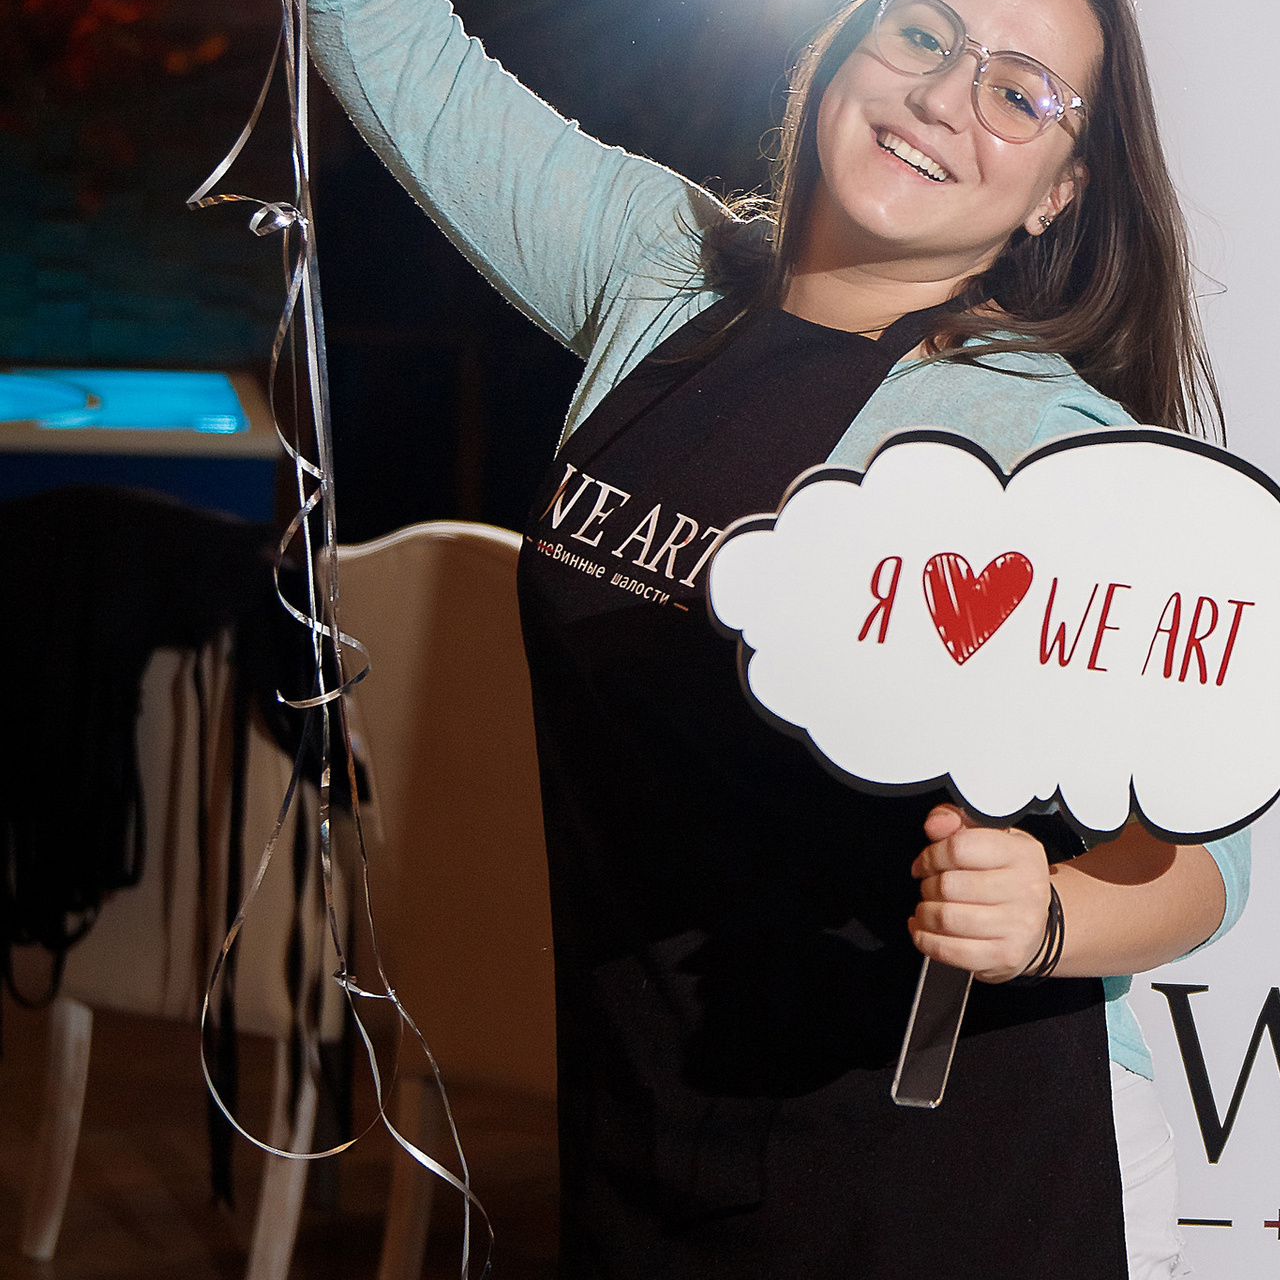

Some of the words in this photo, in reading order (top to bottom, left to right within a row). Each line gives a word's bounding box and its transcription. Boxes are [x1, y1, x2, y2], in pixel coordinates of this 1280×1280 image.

[611, 503, 724, 588] ART
[610, 572, 670, 606] шалости
[857, 556, 903, 644] Я
[1038, 576, 1131, 673] WE
[1141, 591, 1256, 687] ART
